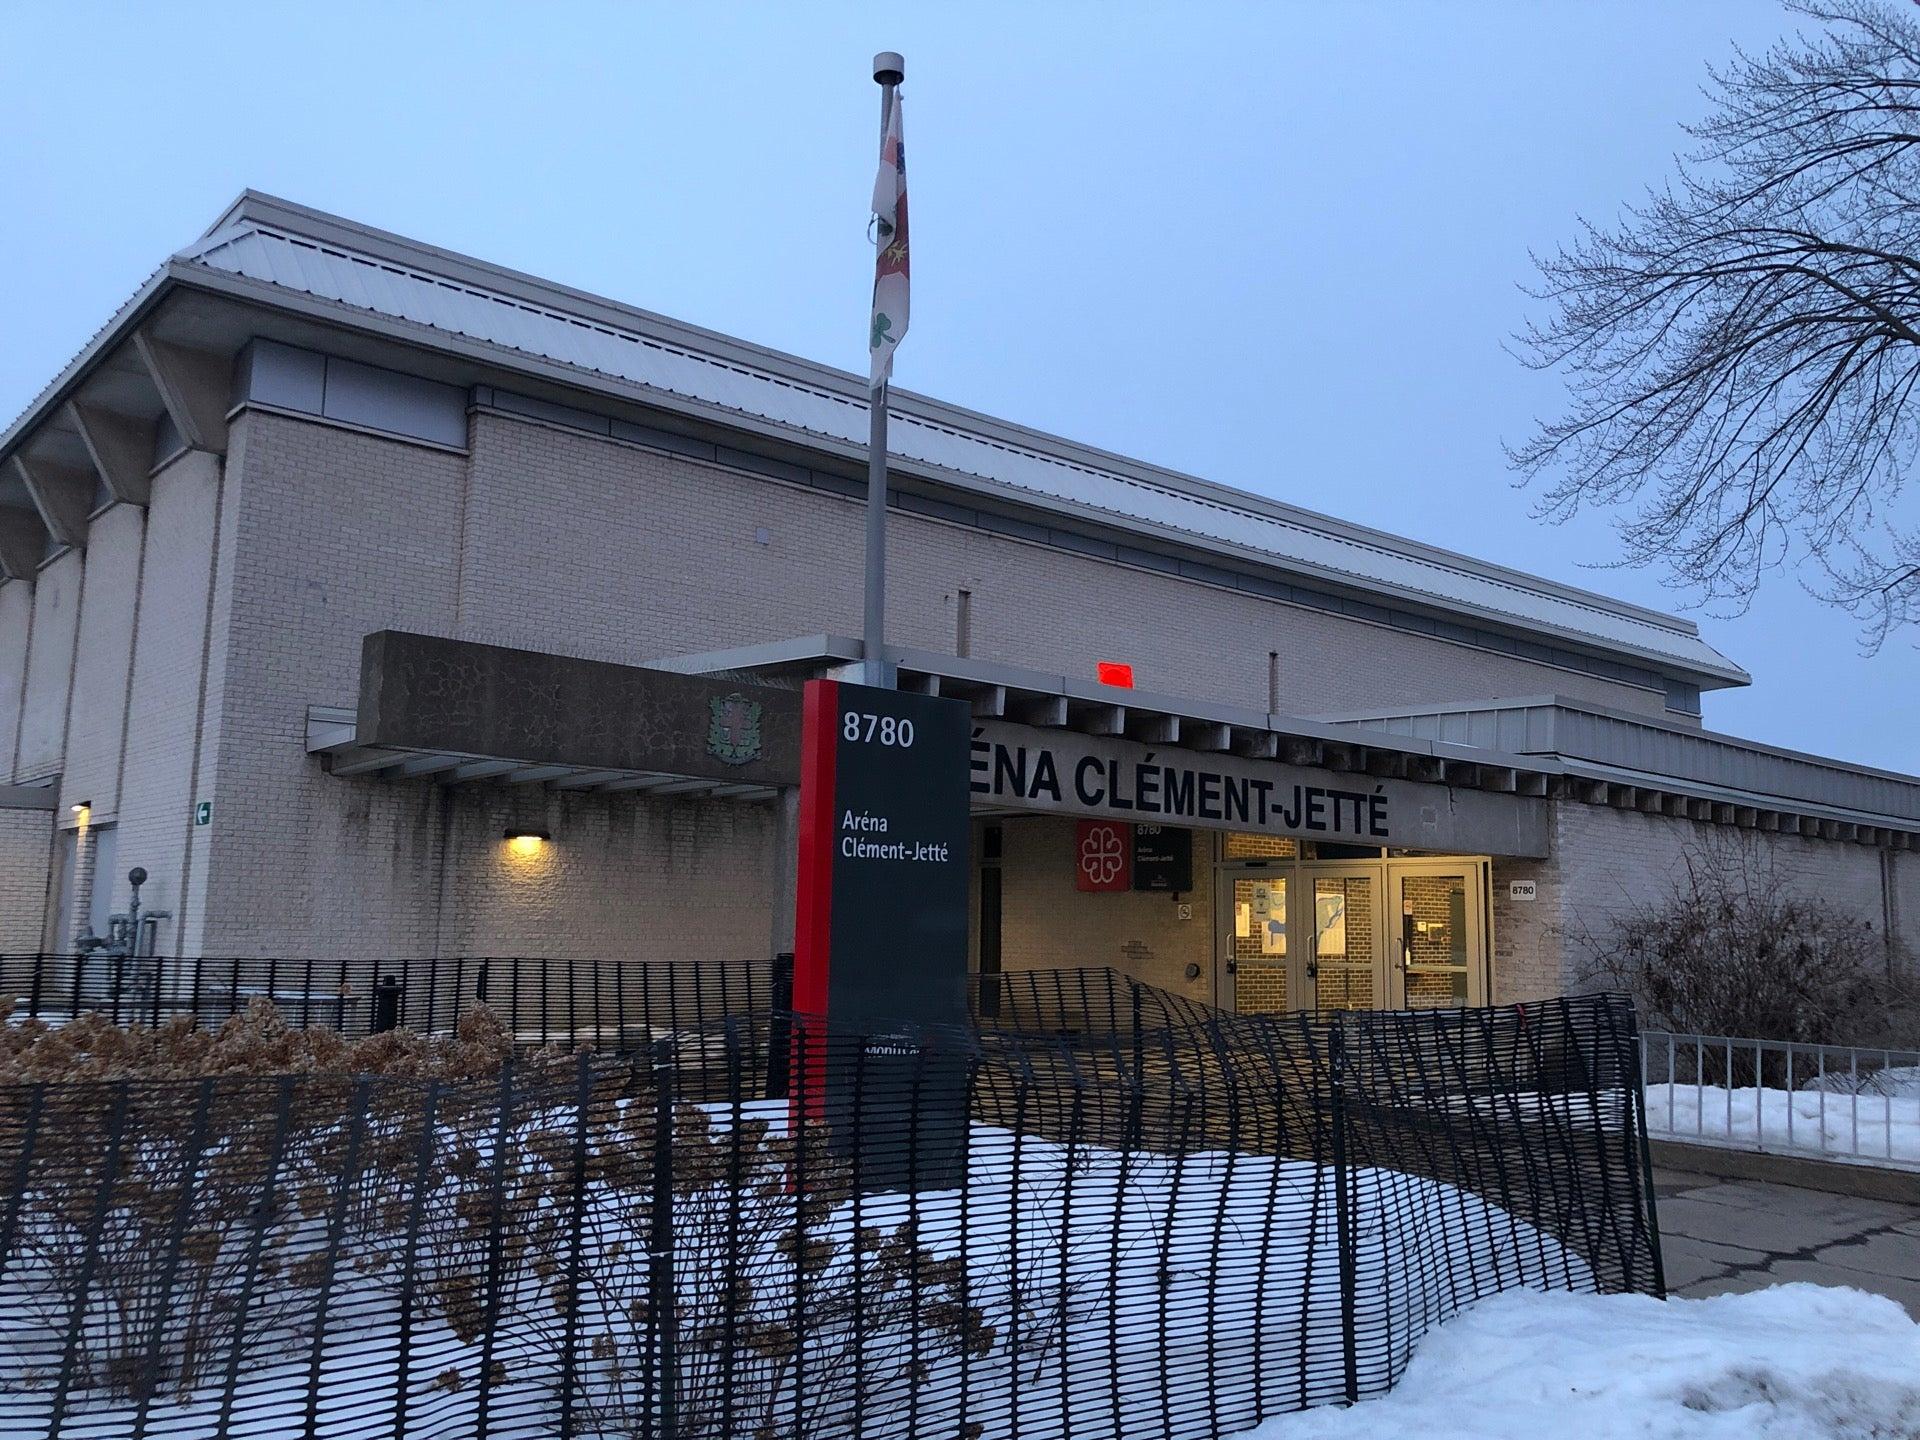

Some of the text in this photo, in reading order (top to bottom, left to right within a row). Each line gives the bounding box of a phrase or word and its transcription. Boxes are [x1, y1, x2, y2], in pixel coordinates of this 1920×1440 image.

[843, 711, 914, 748] 8780
[1074, 752, 1389, 838] CLÉMENT-JETTÉ
[842, 810, 888, 833] Aréna
[842, 837, 948, 862] Clément-Jetté
[1512, 886, 1534, 895] 8780
